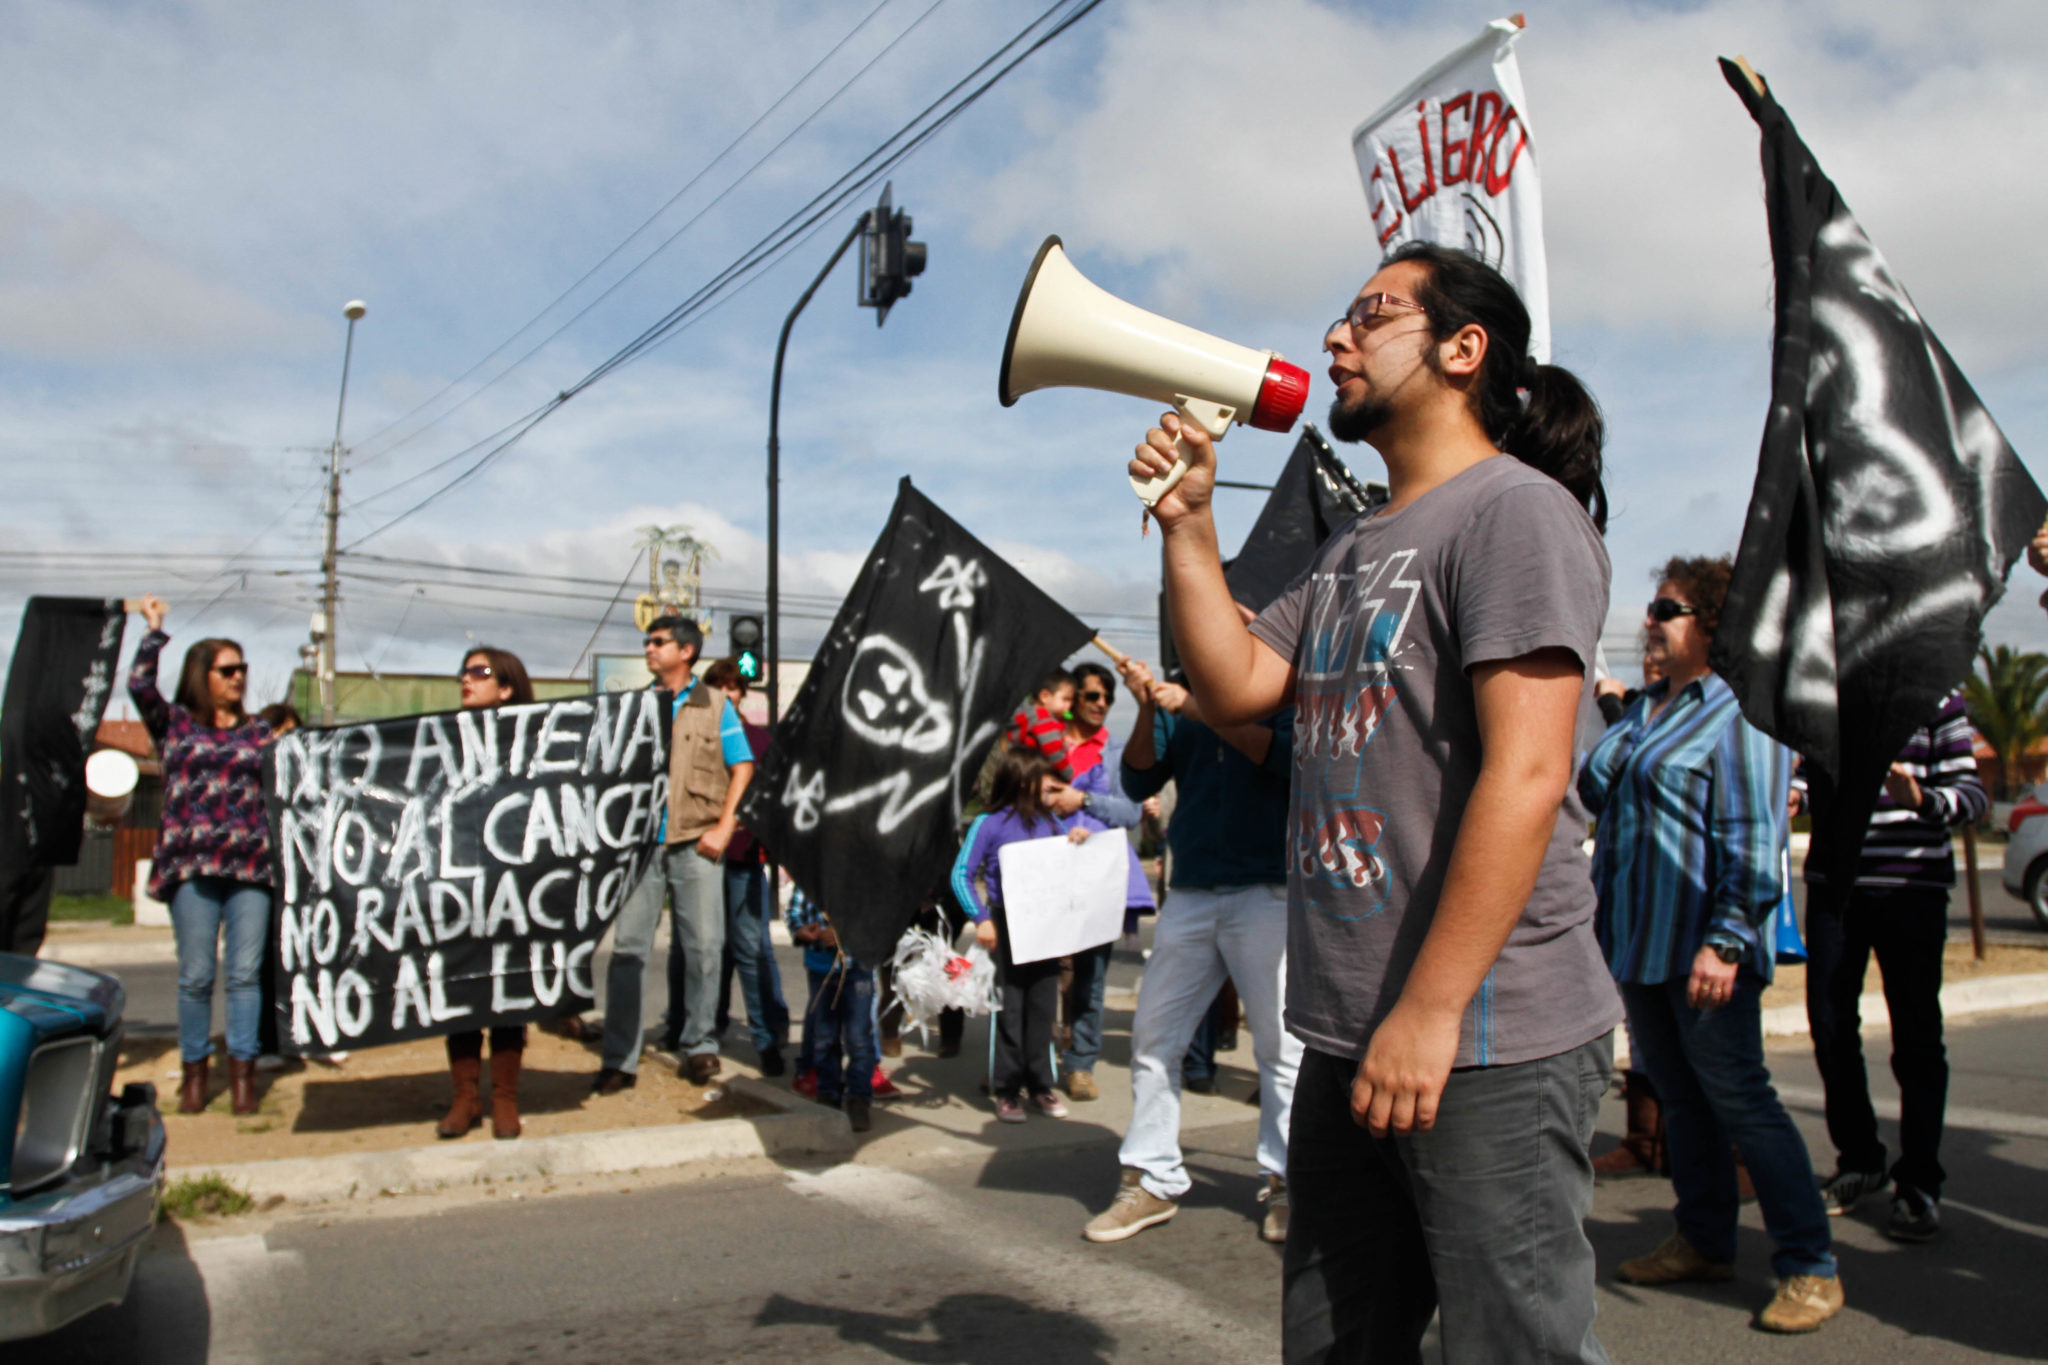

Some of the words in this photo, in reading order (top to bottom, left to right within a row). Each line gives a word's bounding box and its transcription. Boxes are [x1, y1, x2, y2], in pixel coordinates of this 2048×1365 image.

[275, 724, 383, 803] NO
[404, 689, 665, 789] ANTENA
[279, 796, 374, 903] NO
[382, 790, 486, 887] AL
[484, 772, 669, 865] CANCER
[280, 898, 341, 972] NO
[290, 967, 374, 1047] NO
[391, 951, 474, 1031] AL
